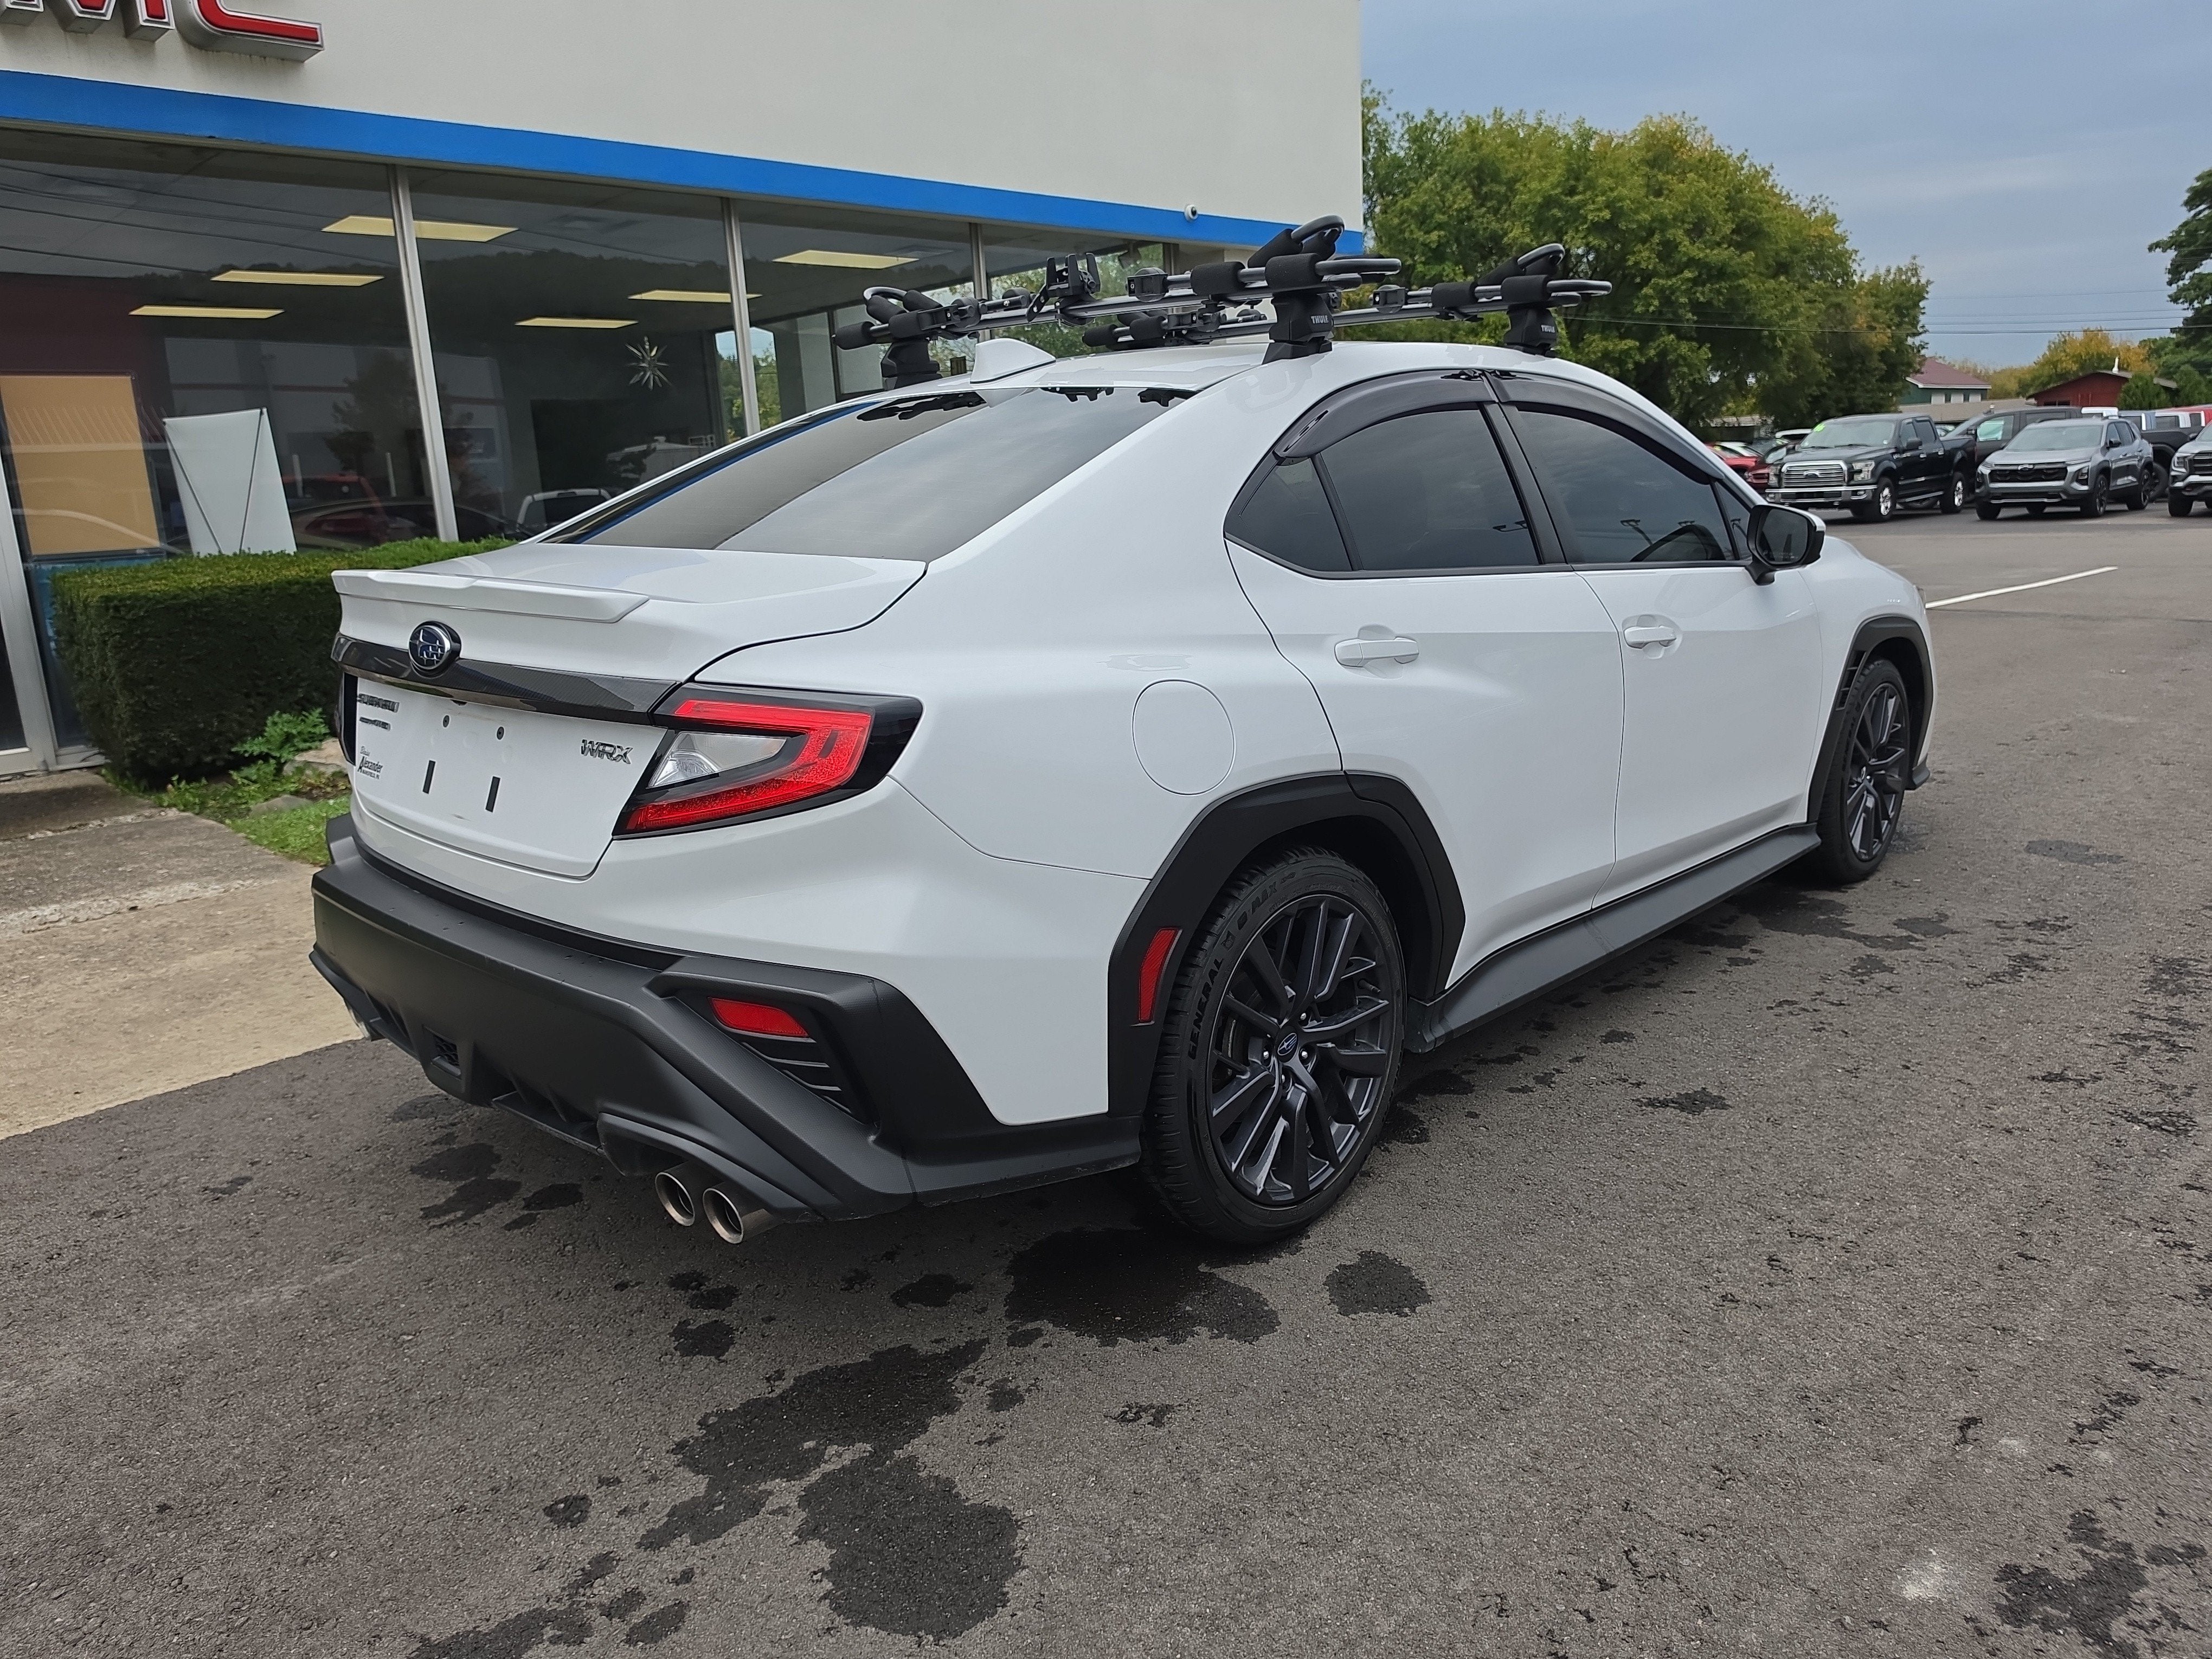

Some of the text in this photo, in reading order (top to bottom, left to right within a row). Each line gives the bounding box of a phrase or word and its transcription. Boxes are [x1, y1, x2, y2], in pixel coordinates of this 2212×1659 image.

[1310, 314, 1329, 324] THULE
[581, 739, 633, 764] WRX
[1187, 956, 1224, 1060] GENERAL
